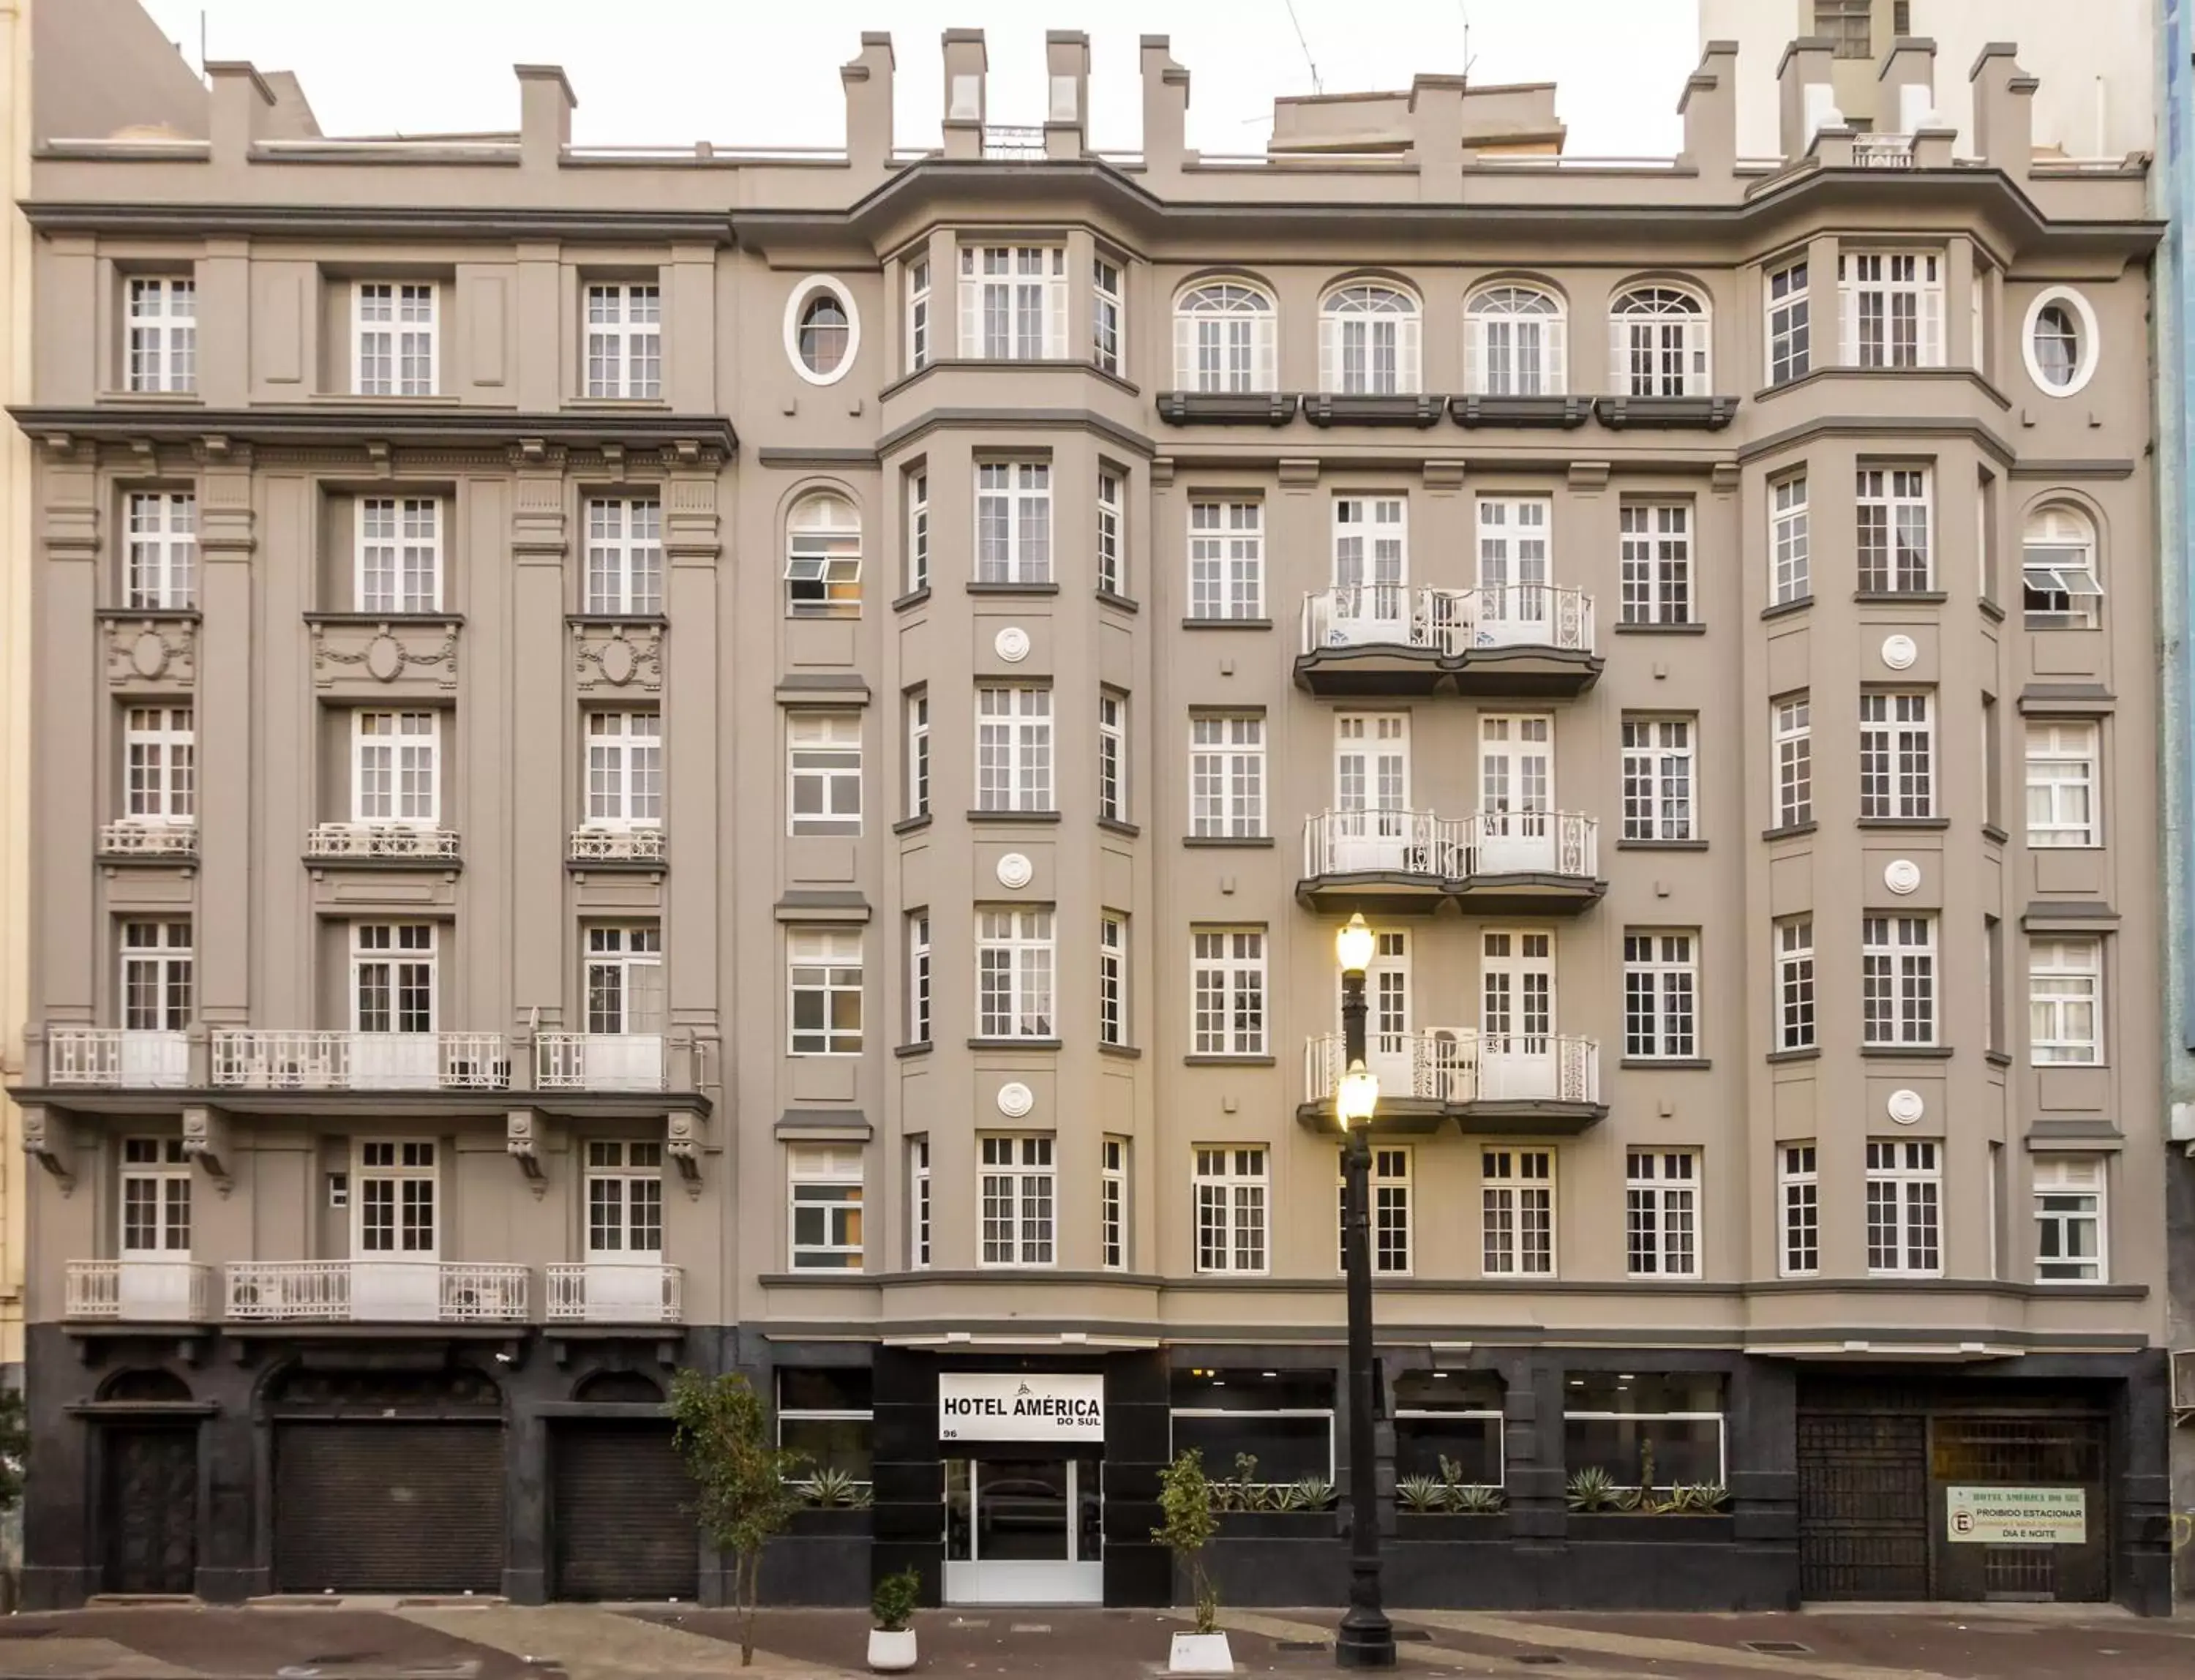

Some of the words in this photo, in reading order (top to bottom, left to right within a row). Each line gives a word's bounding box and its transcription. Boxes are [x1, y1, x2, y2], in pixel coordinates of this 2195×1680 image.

[945, 1398, 1007, 1415] HOTEL
[1013, 1395, 1100, 1416] AMÉRICA
[1057, 1417, 1073, 1425] DO
[1078, 1417, 1100, 1426] SUL
[943, 1429, 957, 1438] 96
[1976, 1509, 2021, 1517] PROIBIDO
[2023, 1510, 2082, 1518] ESTACIONAR
[2029, 1530, 2056, 1538] NOITE
